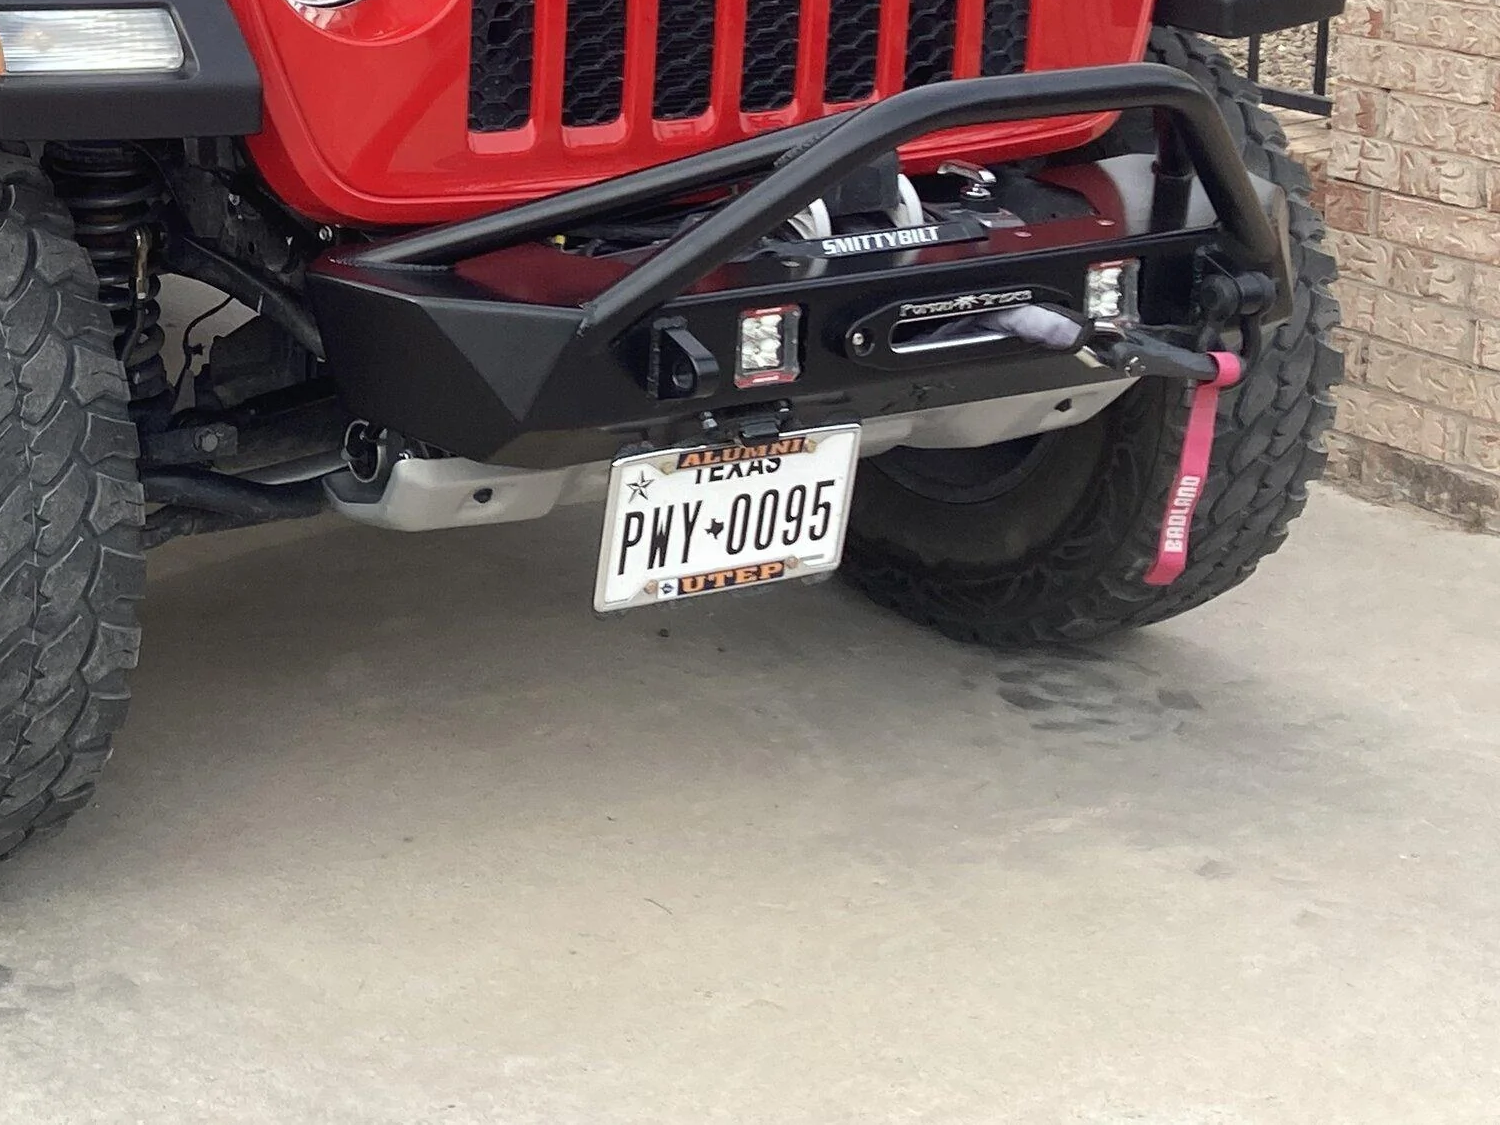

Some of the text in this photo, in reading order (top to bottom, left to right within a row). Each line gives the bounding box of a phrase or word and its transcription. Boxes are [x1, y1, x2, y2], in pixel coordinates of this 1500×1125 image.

[821, 226, 940, 255] SMITTYBILT
[680, 438, 805, 469] ALUMNI
[694, 457, 782, 485] TEXAS
[617, 479, 836, 576] PWY 0095
[1164, 475, 1200, 553] BADLAND
[680, 561, 785, 594] UTEP
